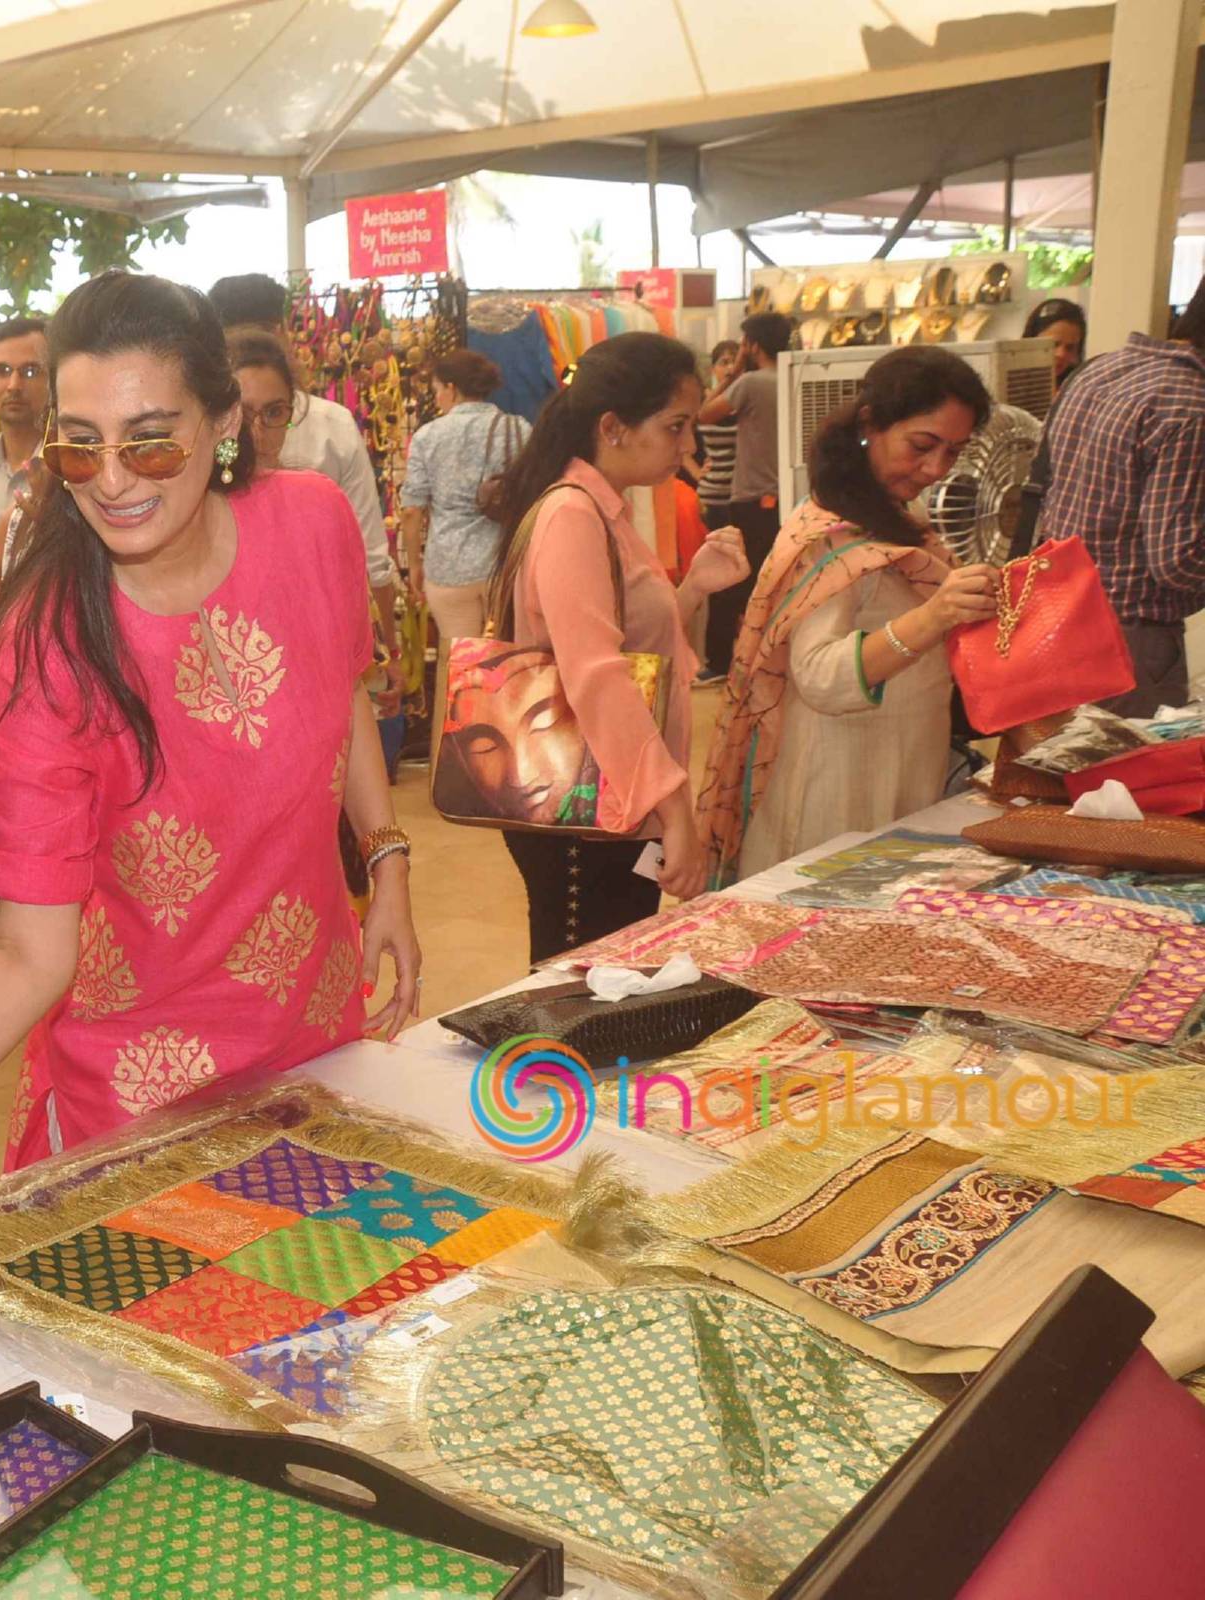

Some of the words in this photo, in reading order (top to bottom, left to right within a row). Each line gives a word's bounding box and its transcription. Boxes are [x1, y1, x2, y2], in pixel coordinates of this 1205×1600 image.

[362, 207, 427, 227] Aeshaane
[360, 231, 376, 252] by
[372, 248, 422, 267] Amrish
